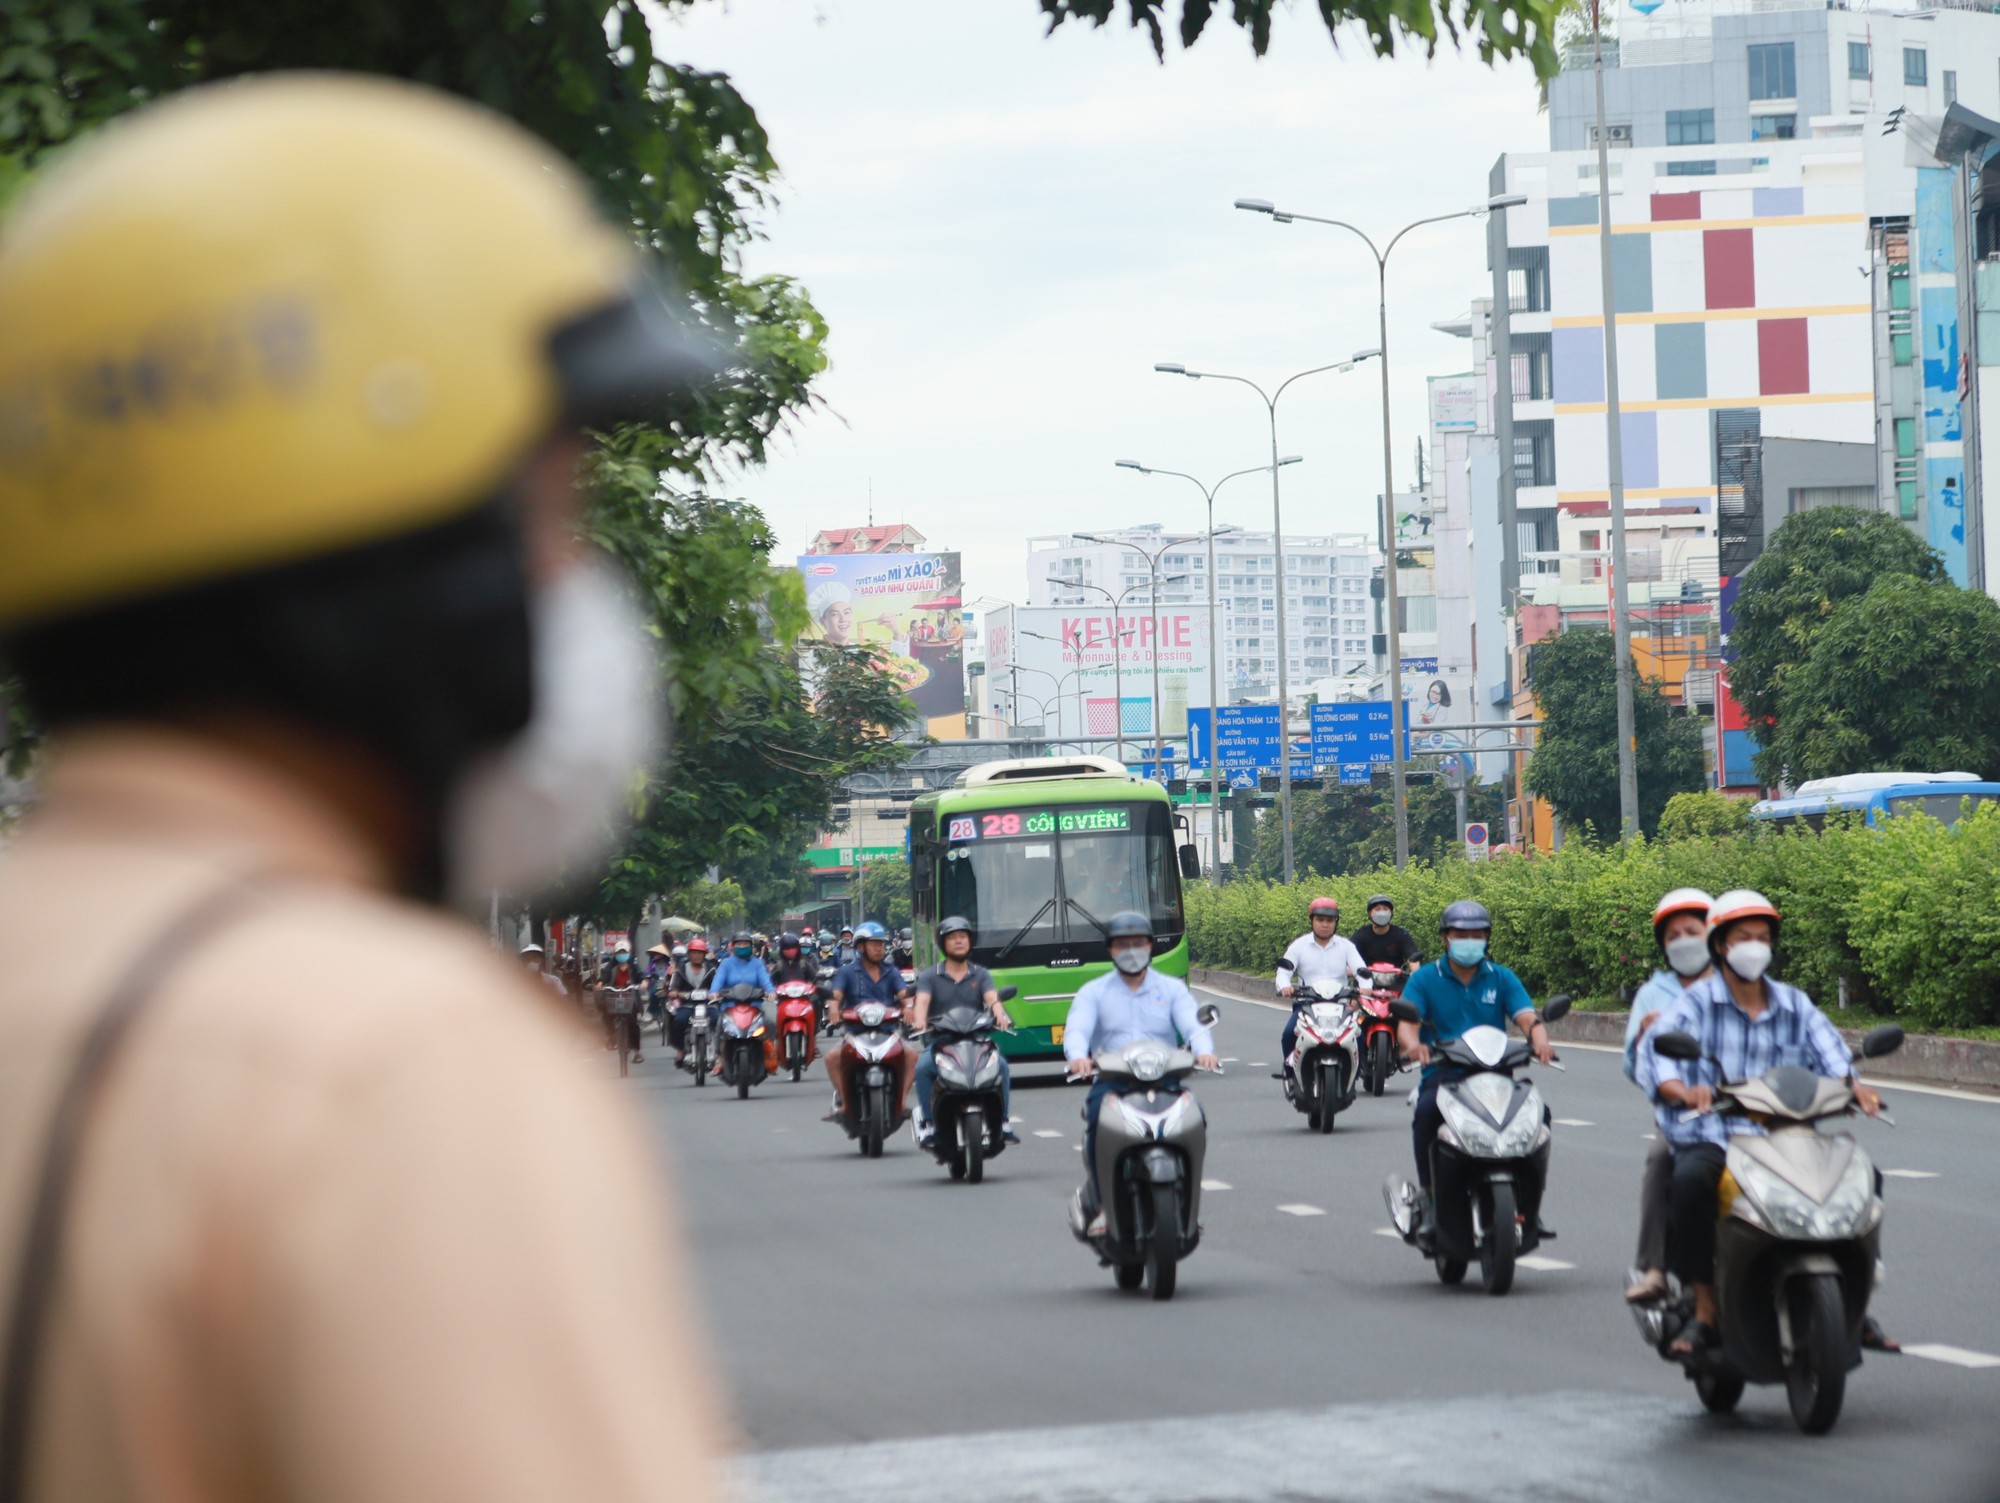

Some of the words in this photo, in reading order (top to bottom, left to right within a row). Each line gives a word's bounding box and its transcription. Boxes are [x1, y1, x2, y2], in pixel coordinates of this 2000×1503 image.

[1062, 616, 1192, 650] KEWPIE
[1132, 650, 1140, 661] &
[1146, 650, 1192, 662] Dessing
[951, 821, 973, 838] 28
[982, 814, 1020, 836] 28
